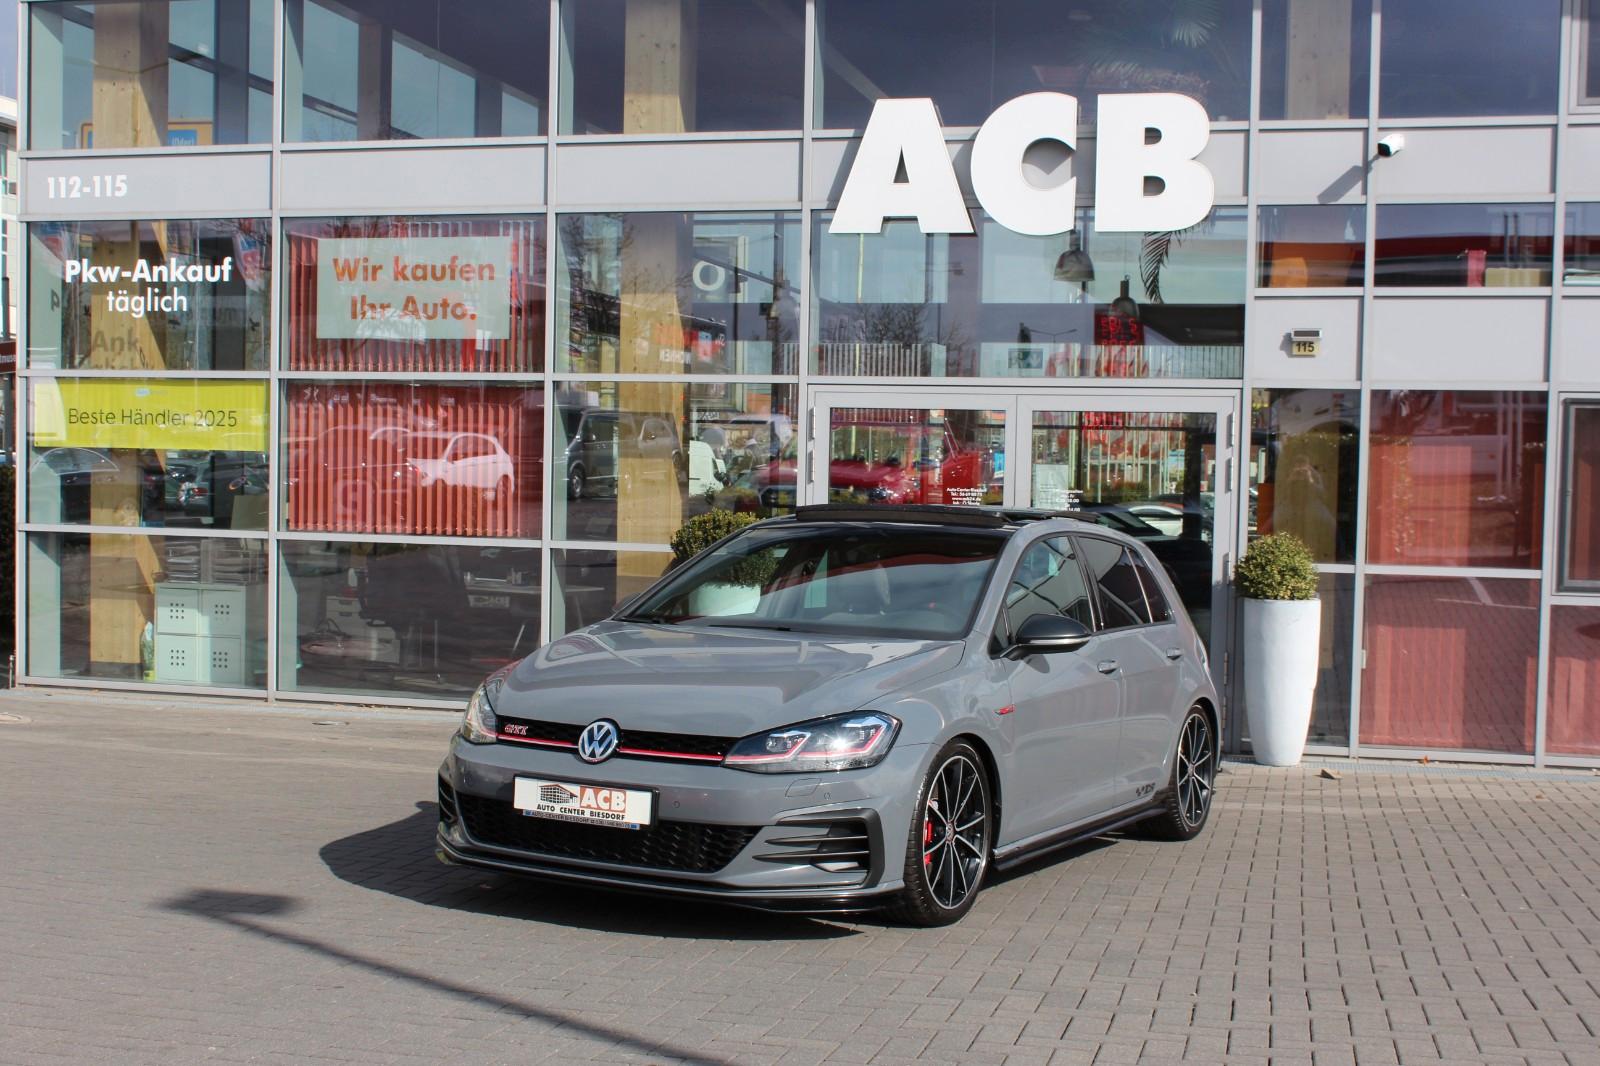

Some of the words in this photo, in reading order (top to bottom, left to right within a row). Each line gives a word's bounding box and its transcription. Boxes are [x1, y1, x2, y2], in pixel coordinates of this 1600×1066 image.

[828, 92, 1214, 236] ACB
[47, 174, 128, 199] 112-115
[65, 256, 232, 283] Pkw-Ankauf
[332, 257, 384, 282] Wir
[393, 255, 495, 281] kaufen
[107, 287, 187, 318] täglich
[351, 295, 391, 320] Ihr
[400, 295, 477, 320] Auto.
[1295, 341, 1315, 353] 115
[68, 407, 116, 425] Beste
[121, 409, 191, 426] Händler
[193, 410, 238, 427] 2025
[504, 724, 529, 736] GTI
[580, 787, 626, 811] ACB
[537, 803, 556, 812] AUTO
[560, 806, 585, 816] CENTER
[590, 810, 626, 821] BIESDORF
